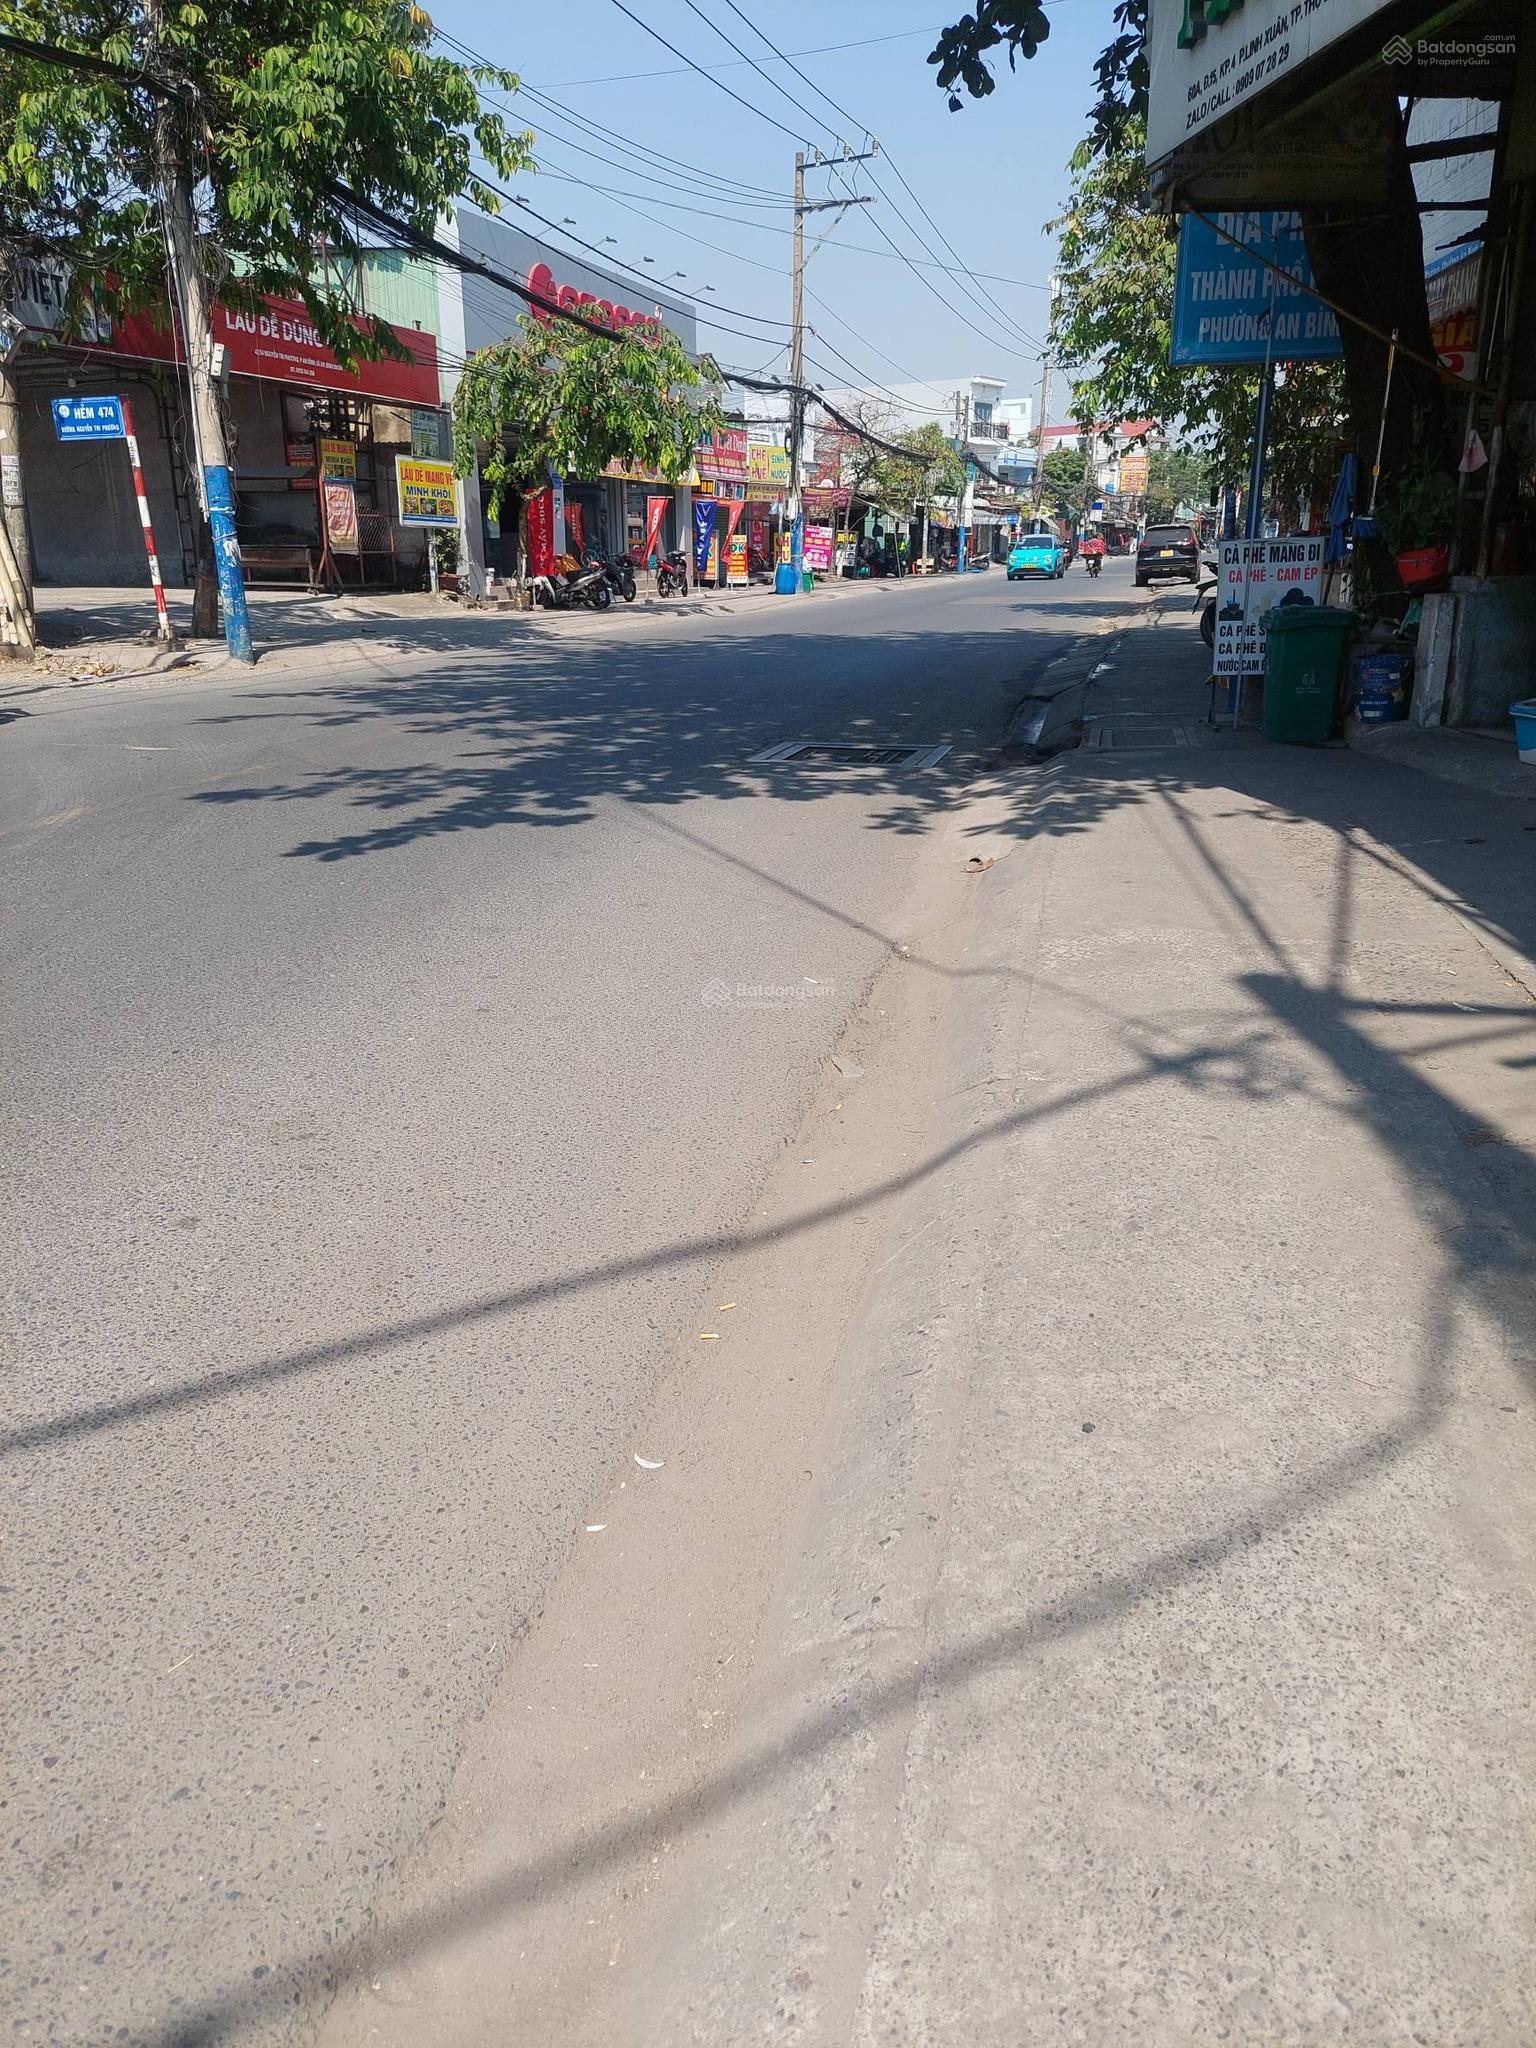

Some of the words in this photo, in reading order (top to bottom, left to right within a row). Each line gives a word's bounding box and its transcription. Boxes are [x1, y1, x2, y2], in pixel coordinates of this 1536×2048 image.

[1255, 59, 1266, 81] 07
[1266, 51, 1277, 74] 28
[1278, 42, 1290, 65] 29
[1191, 264, 1257, 302] THÀNH
[1262, 256, 1303, 298] PHỐ
[259, 312, 280, 339] DÊ
[1199, 308, 1271, 343] PHƯỜNG
[1275, 312, 1300, 340] AN
[74, 403, 95, 420] HẺM
[98, 406, 115, 418] 474
[425, 470, 445, 485] MANG
[405, 485, 429, 497] MINH
[431, 486, 451, 498] KHÔI
[1224, 543, 1239, 565] CÀ
[1243, 541, 1266, 564] PHÊ
[1269, 545, 1305, 563] MANG
[1308, 543, 1321, 561] ĐI
[1228, 567, 1243, 583] CÀ
[1277, 567, 1301, 581] CAM
[1304, 564, 1318, 581] ÉP
[1219, 623, 1233, 637] CÀ
[1236, 622, 1256, 637] PHÊ
[1218, 641, 1233, 655] CÀ
[1235, 640, 1257, 654] PHÊ
[1217, 658, 1240, 672] NƯỚC
[1241, 659, 1260, 671] CAM
